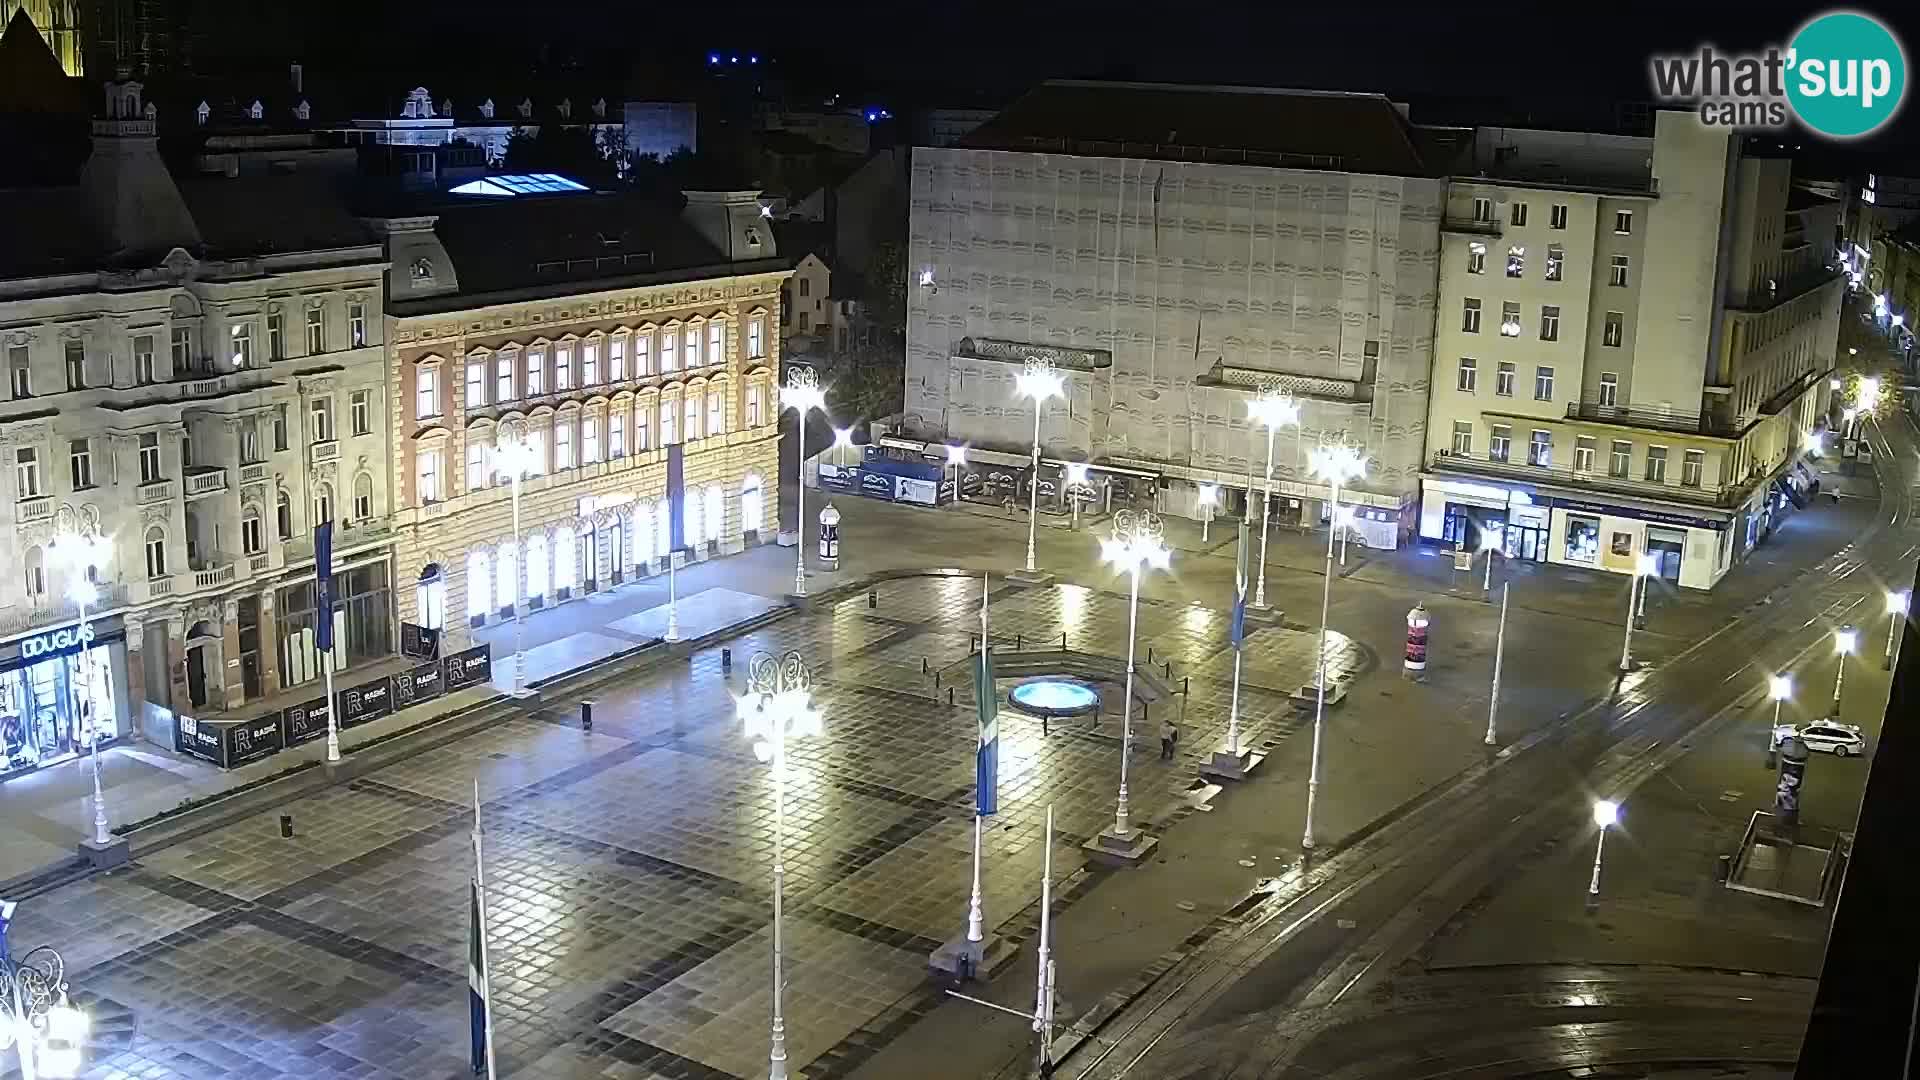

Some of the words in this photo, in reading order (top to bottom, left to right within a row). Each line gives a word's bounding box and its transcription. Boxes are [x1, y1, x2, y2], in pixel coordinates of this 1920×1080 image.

[21, 623, 95, 658] DOUGLAS
[448, 658, 464, 681] R
[398, 675, 415, 698] R
[346, 691, 364, 714] R
[291, 708, 308, 732] R
[234, 727, 252, 753] R
